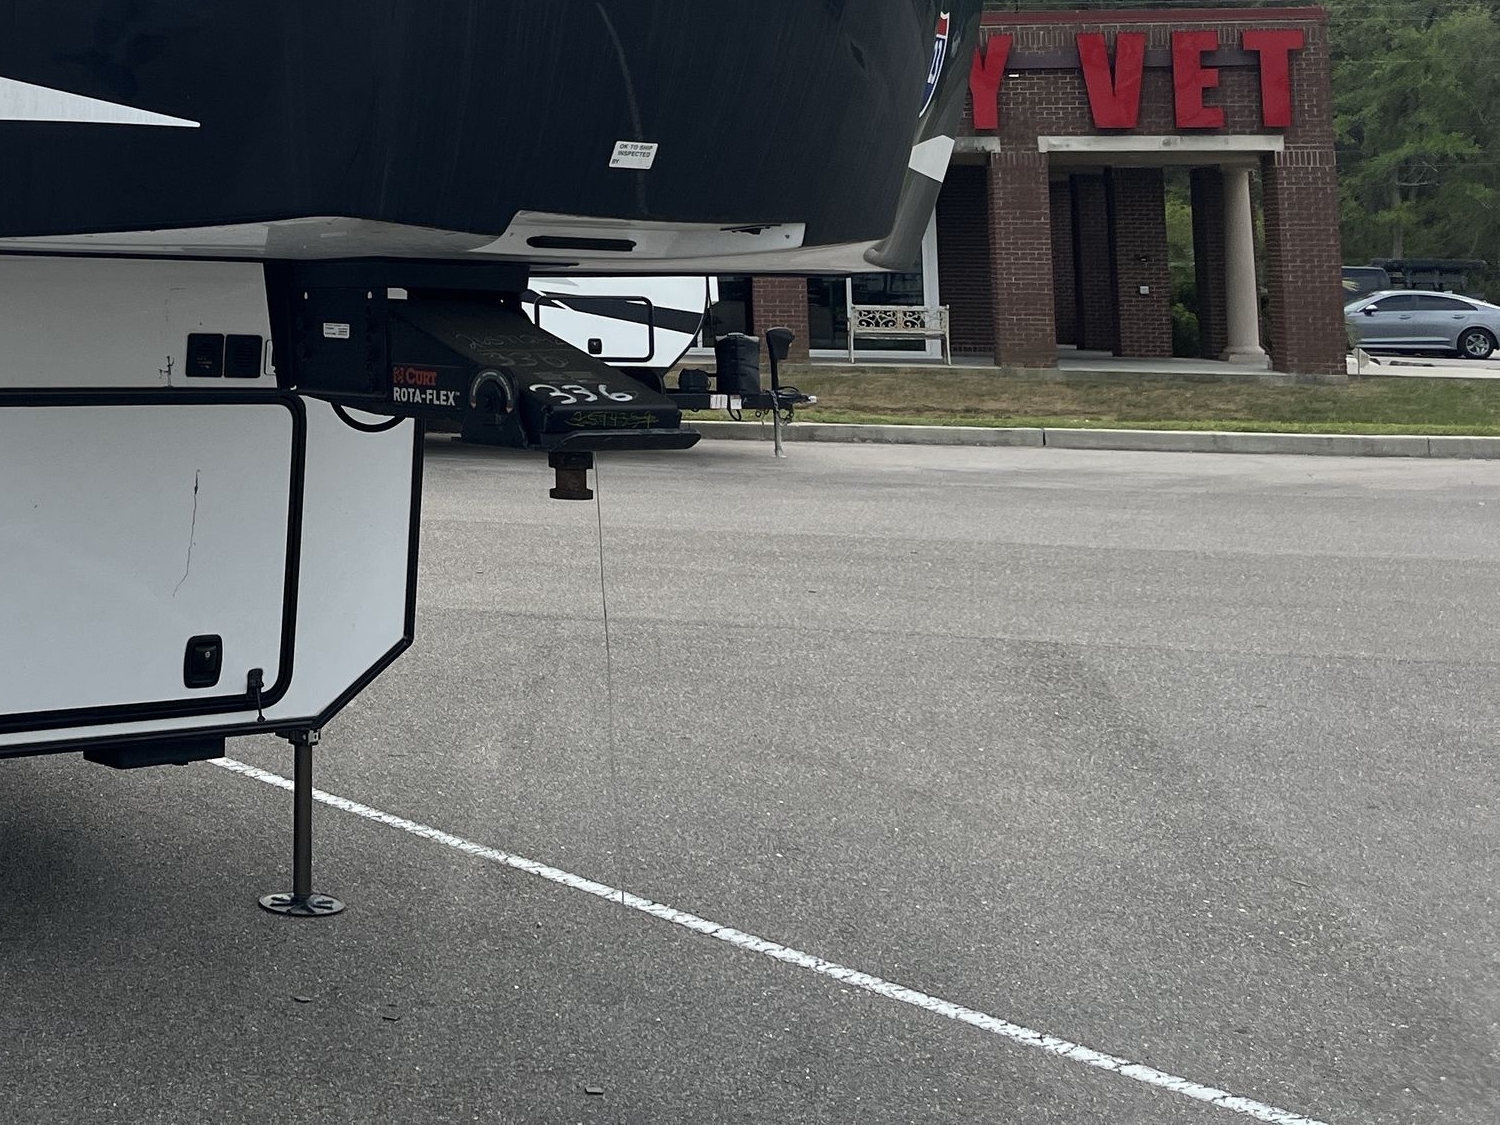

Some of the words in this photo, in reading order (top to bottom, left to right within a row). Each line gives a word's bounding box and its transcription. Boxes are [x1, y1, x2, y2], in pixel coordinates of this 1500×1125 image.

[1077, 30, 1306, 129] VET
[405, 367, 438, 386] CURT
[529, 383, 634, 405] 336
